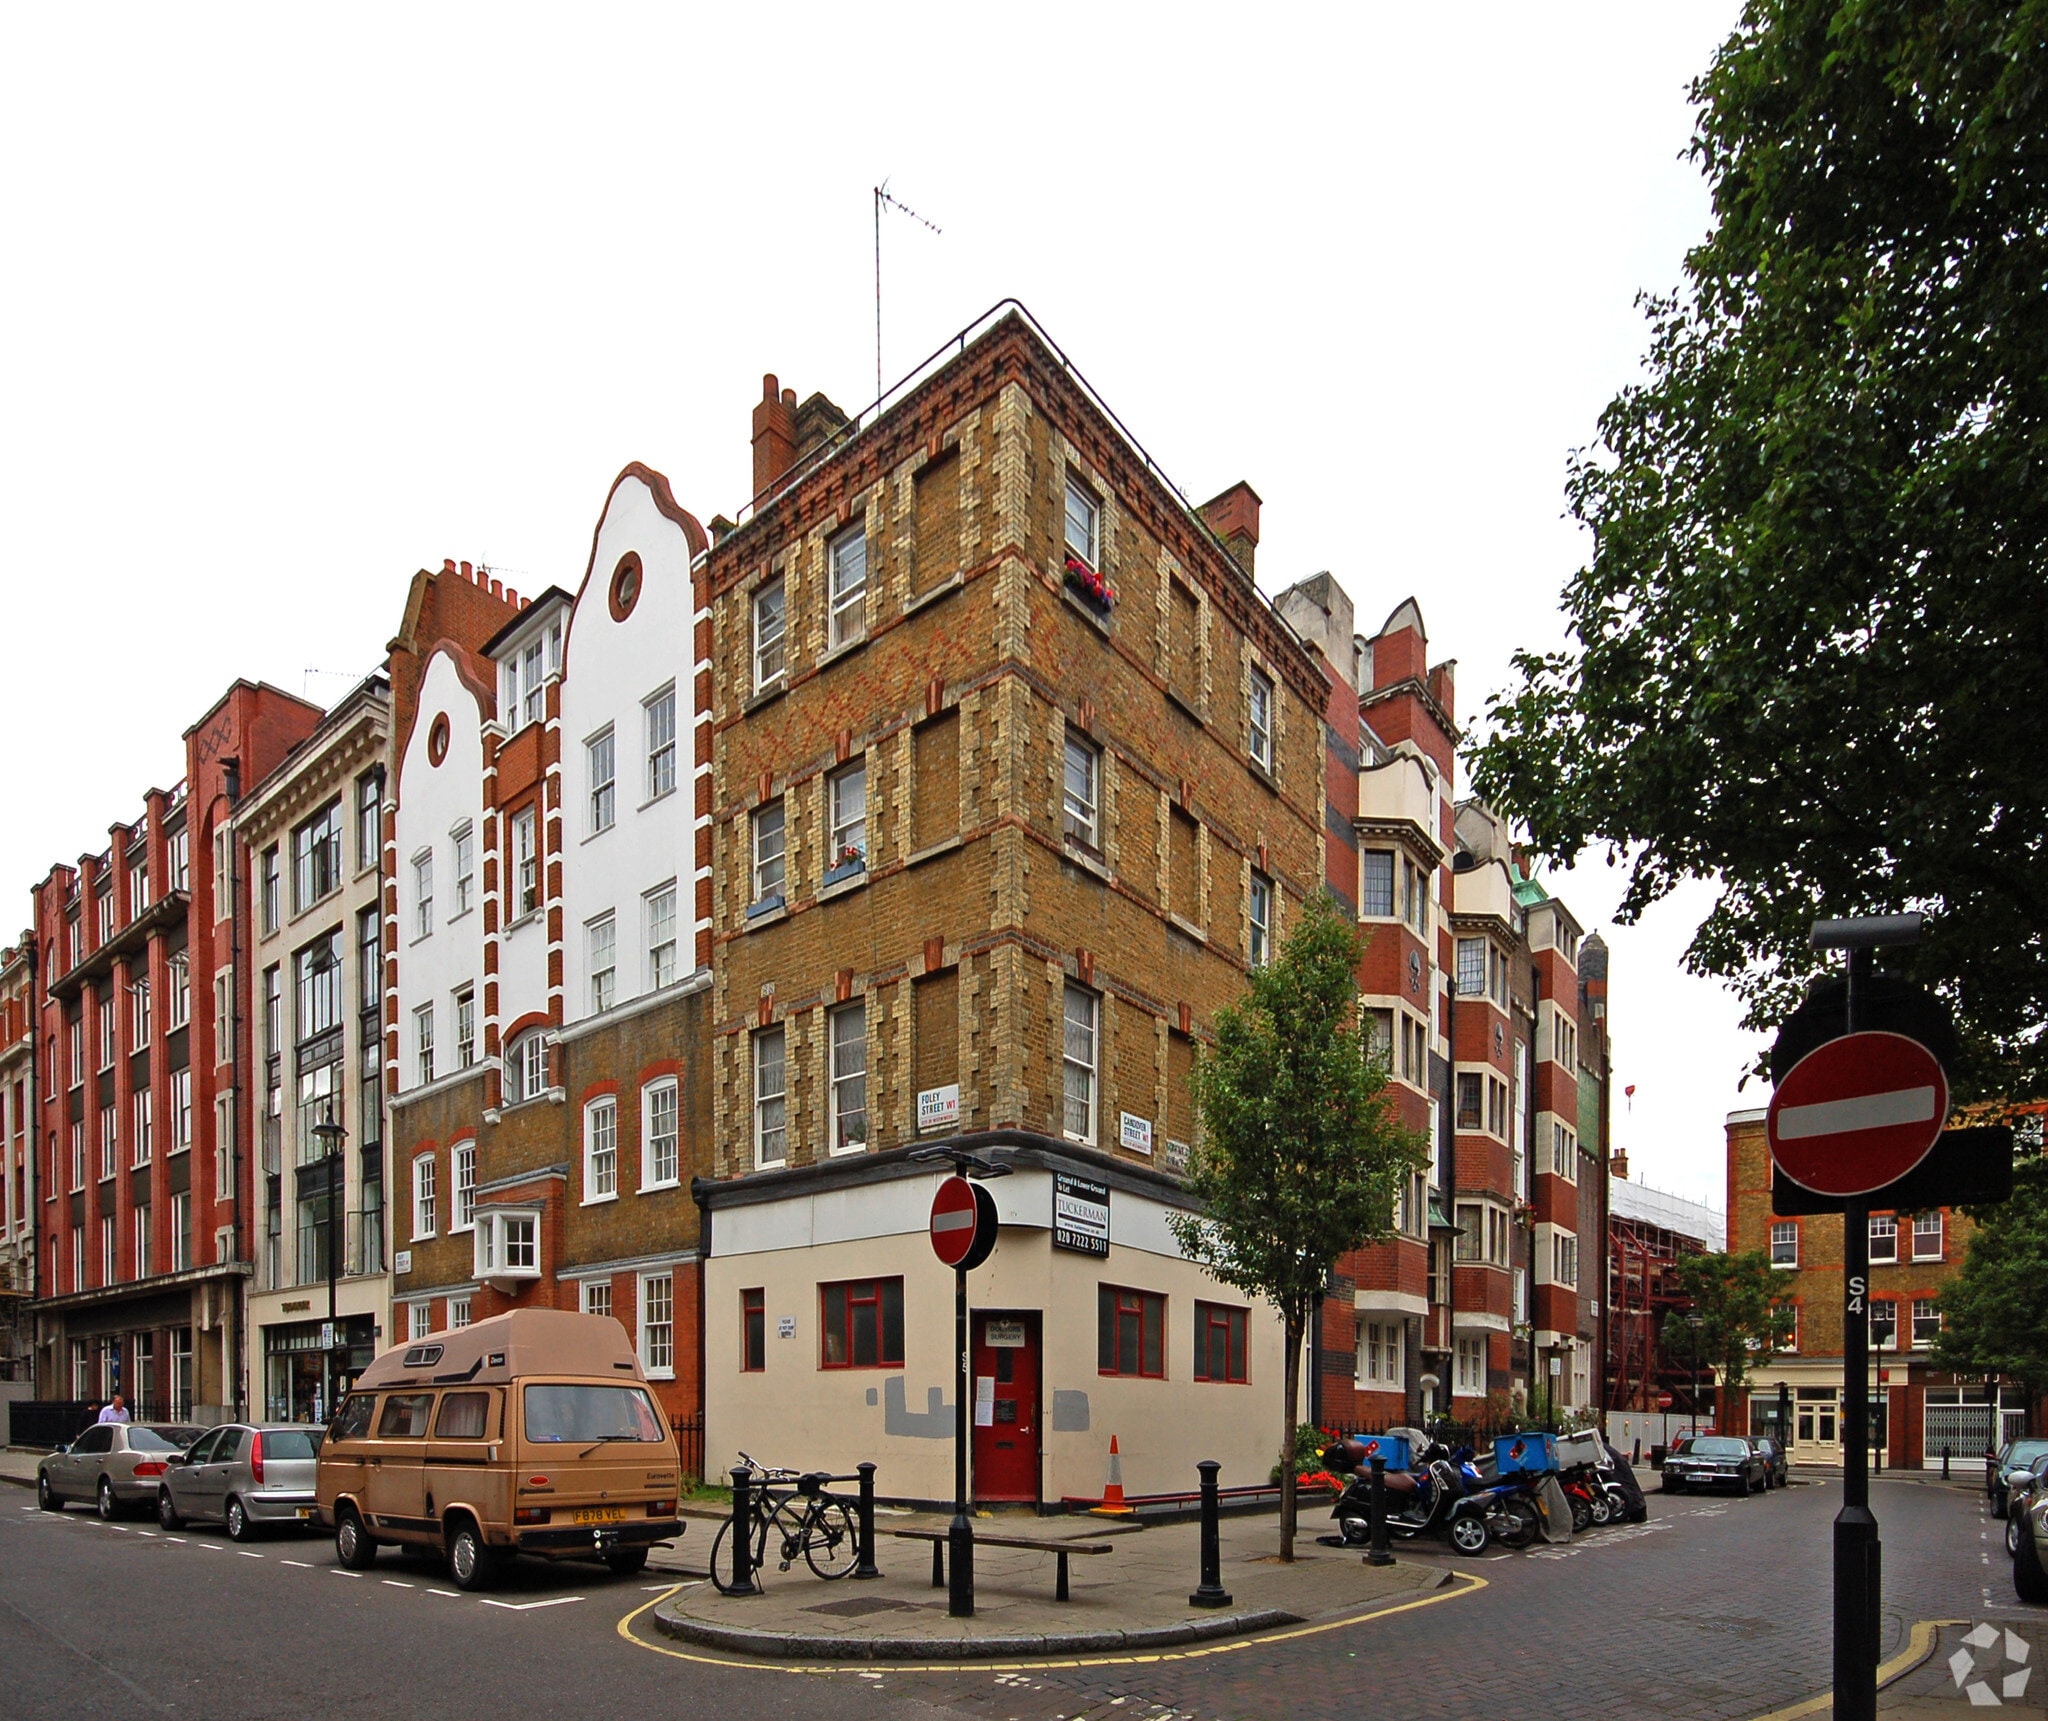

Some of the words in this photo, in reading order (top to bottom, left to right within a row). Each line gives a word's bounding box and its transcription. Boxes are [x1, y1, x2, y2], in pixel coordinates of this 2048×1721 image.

[921, 1092, 940, 1104] FOLEY
[921, 1102, 944, 1115] STREET
[946, 1100, 956, 1110] W1
[1124, 1127, 1140, 1139] STREET
[1057, 1173, 1073, 1185] Ground
[1078, 1180, 1090, 1190] Lower
[1091, 1184, 1105, 1194] Ground
[1058, 1182, 1062, 1190] To
[1057, 1198, 1107, 1223] TUCKERMAN
[1057, 1229, 1070, 1244] 020
[1072, 1233, 1089, 1249] 7222
[1090, 1238, 1107, 1253] 5511
[575, 1510, 603, 1521] F878
[605, 1509, 625, 1520] VEL
